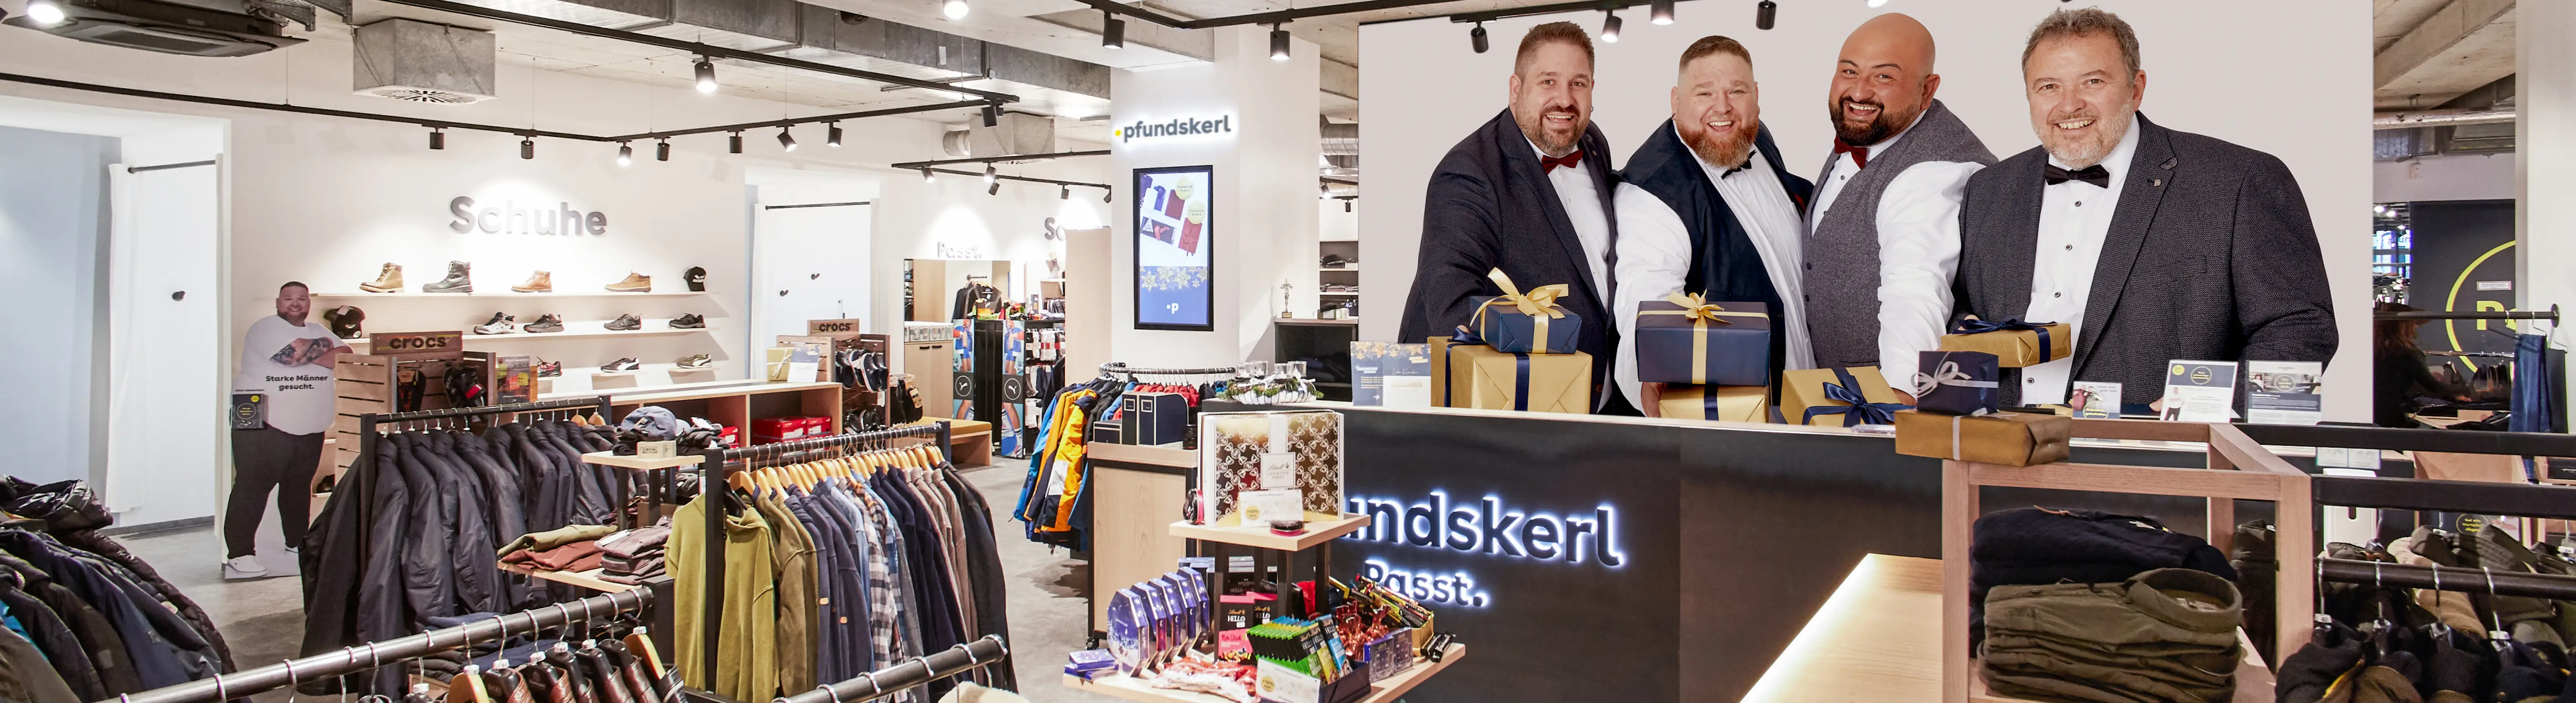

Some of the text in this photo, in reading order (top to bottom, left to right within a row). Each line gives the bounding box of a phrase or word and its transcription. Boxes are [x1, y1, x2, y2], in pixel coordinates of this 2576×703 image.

[1124, 115, 1231, 143] pfundskerl
[450, 196, 607, 237] Schuhe
[819, 323, 851, 332] crocs
[390, 337, 447, 349] crocs
[1365, 560, 1488, 608] Passt.
